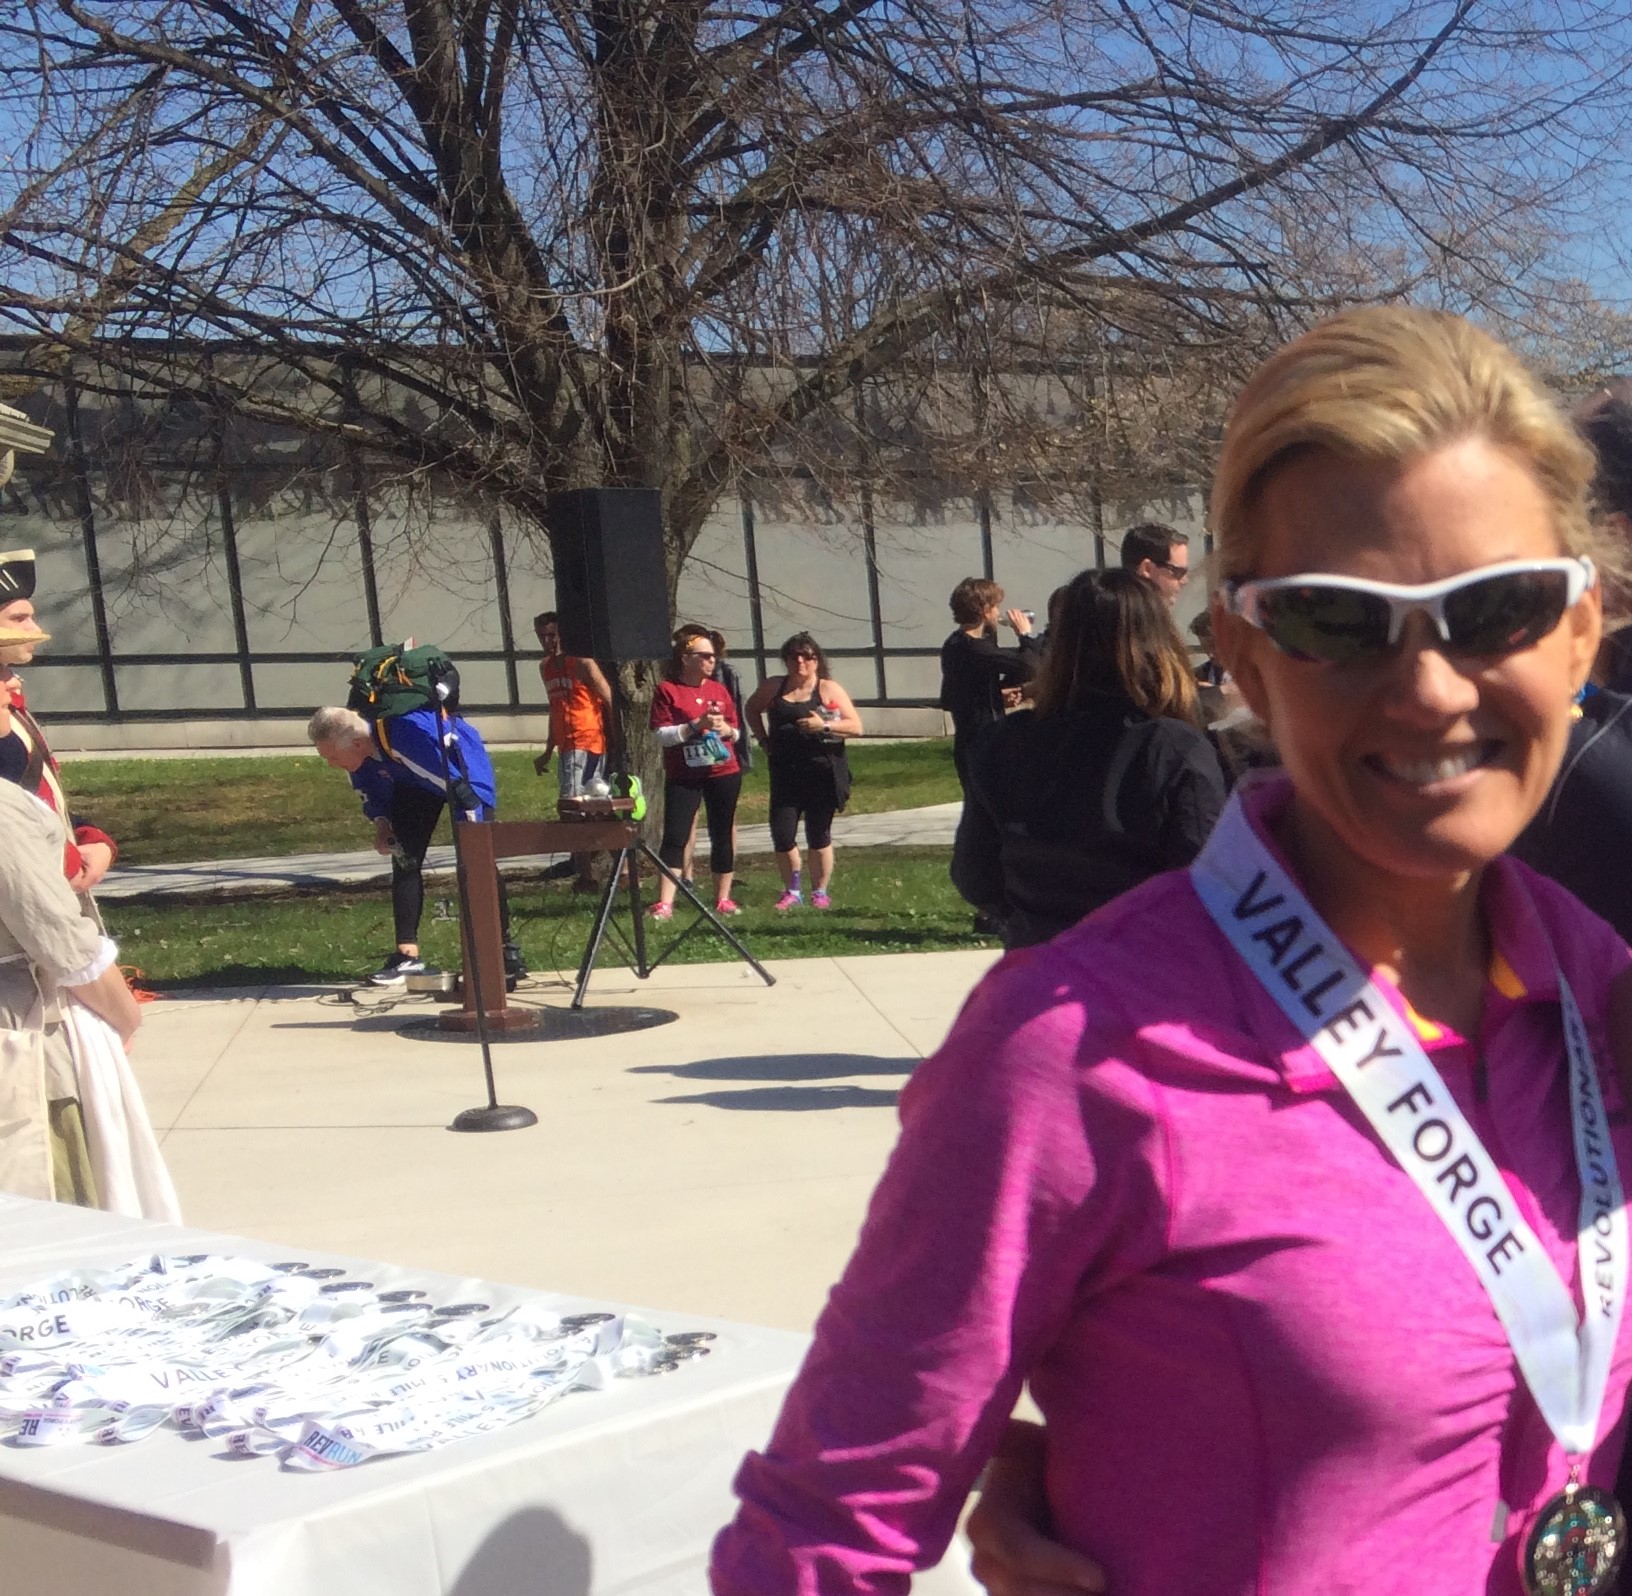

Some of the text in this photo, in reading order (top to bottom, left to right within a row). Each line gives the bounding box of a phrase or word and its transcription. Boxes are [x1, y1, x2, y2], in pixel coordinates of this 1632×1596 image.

[1231, 870, 1528, 1277] VALLEY FORGE
[150, 1363, 247, 1389] VALLEY
[304, 1430, 362, 1464] REVRUN
